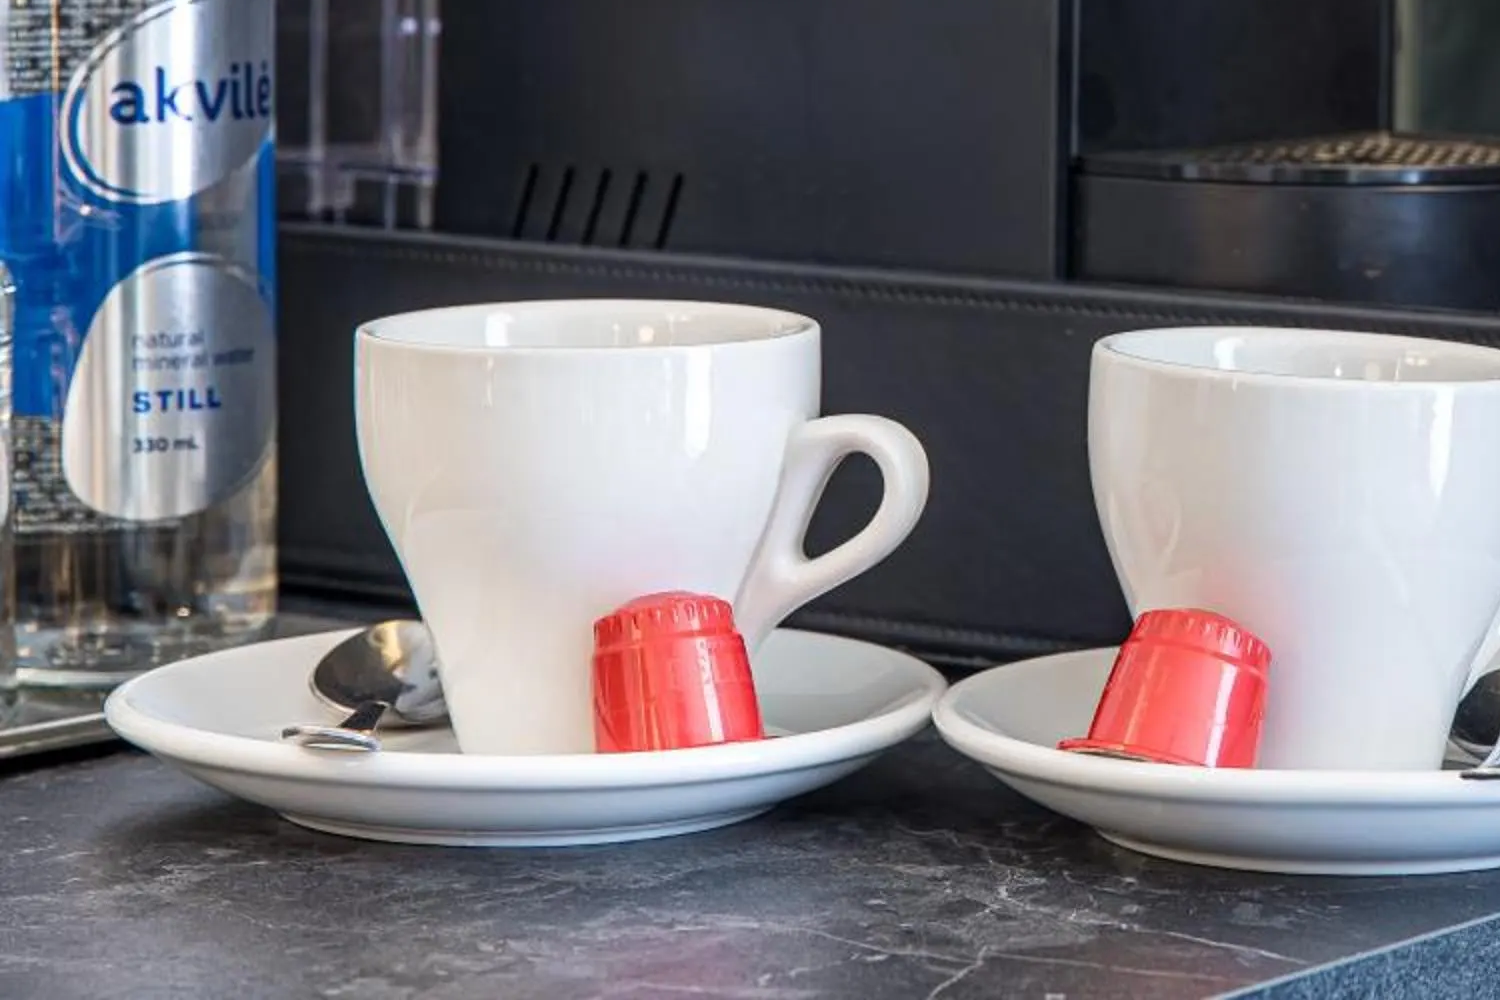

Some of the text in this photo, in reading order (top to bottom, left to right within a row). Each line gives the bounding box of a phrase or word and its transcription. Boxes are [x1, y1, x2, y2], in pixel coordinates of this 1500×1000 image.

[132, 330, 204, 349] natural
[132, 351, 209, 371] mineral
[132, 387, 222, 414] STILL
[132, 436, 169, 453] 330
